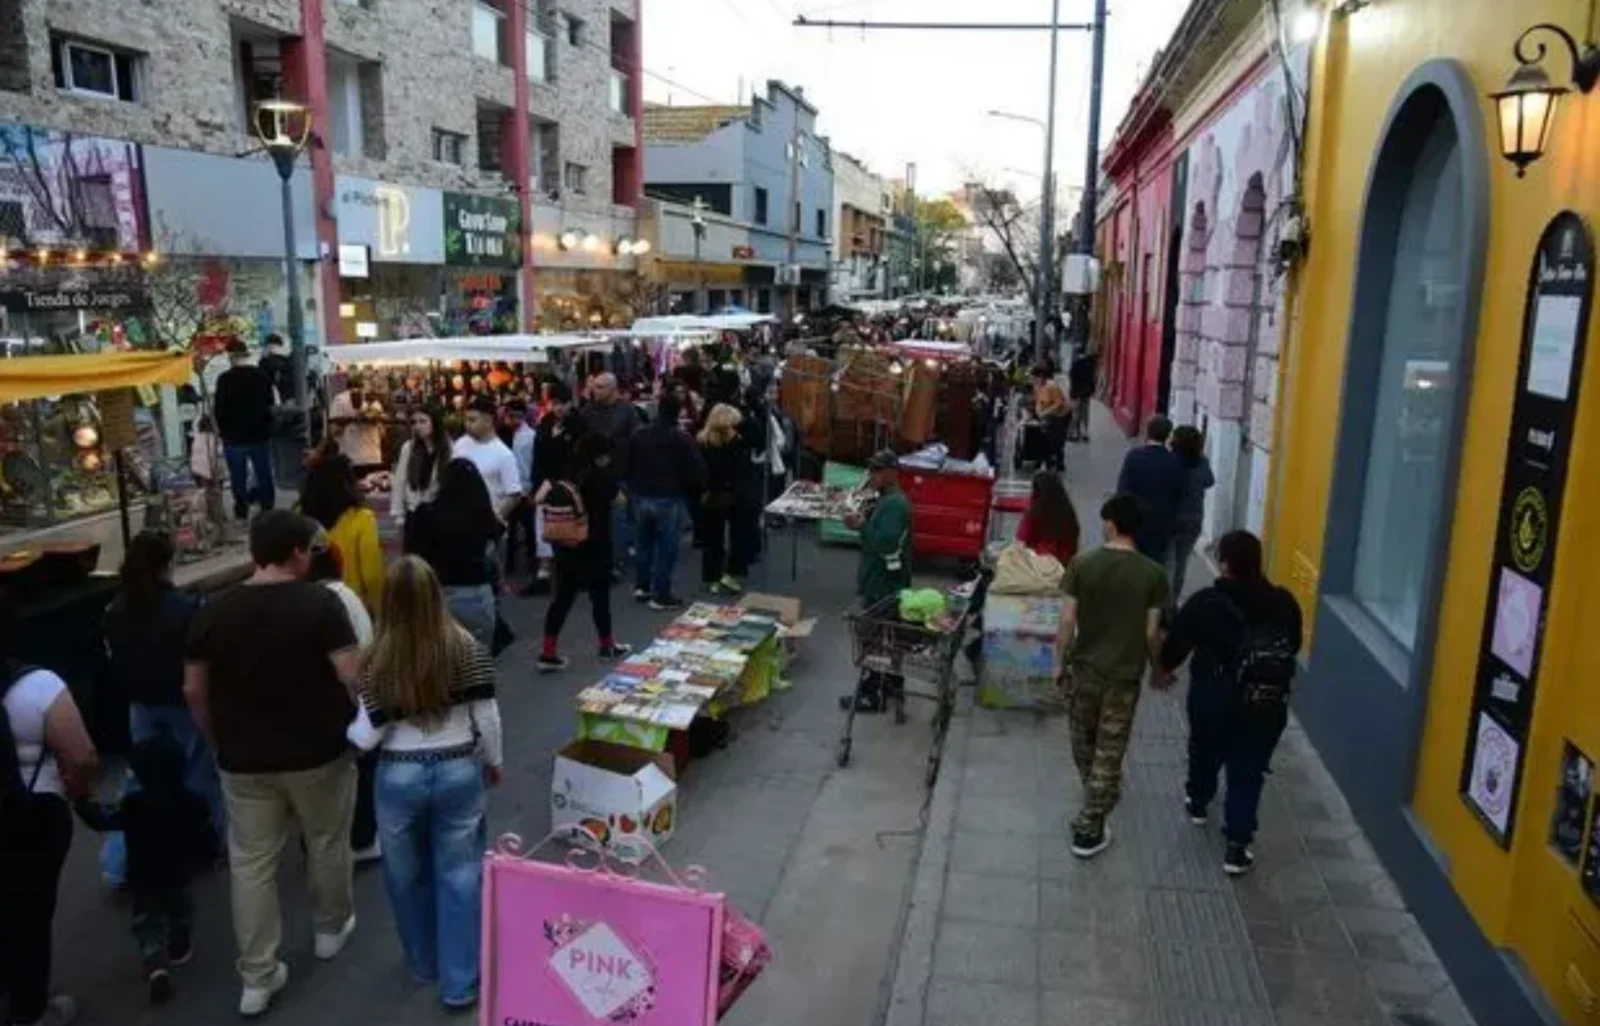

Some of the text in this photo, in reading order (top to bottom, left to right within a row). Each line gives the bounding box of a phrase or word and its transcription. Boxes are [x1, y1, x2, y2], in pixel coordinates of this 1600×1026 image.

[25, 291, 70, 307] Tienda
[72, 292, 87, 306] de
[569, 947, 631, 980] PINK
